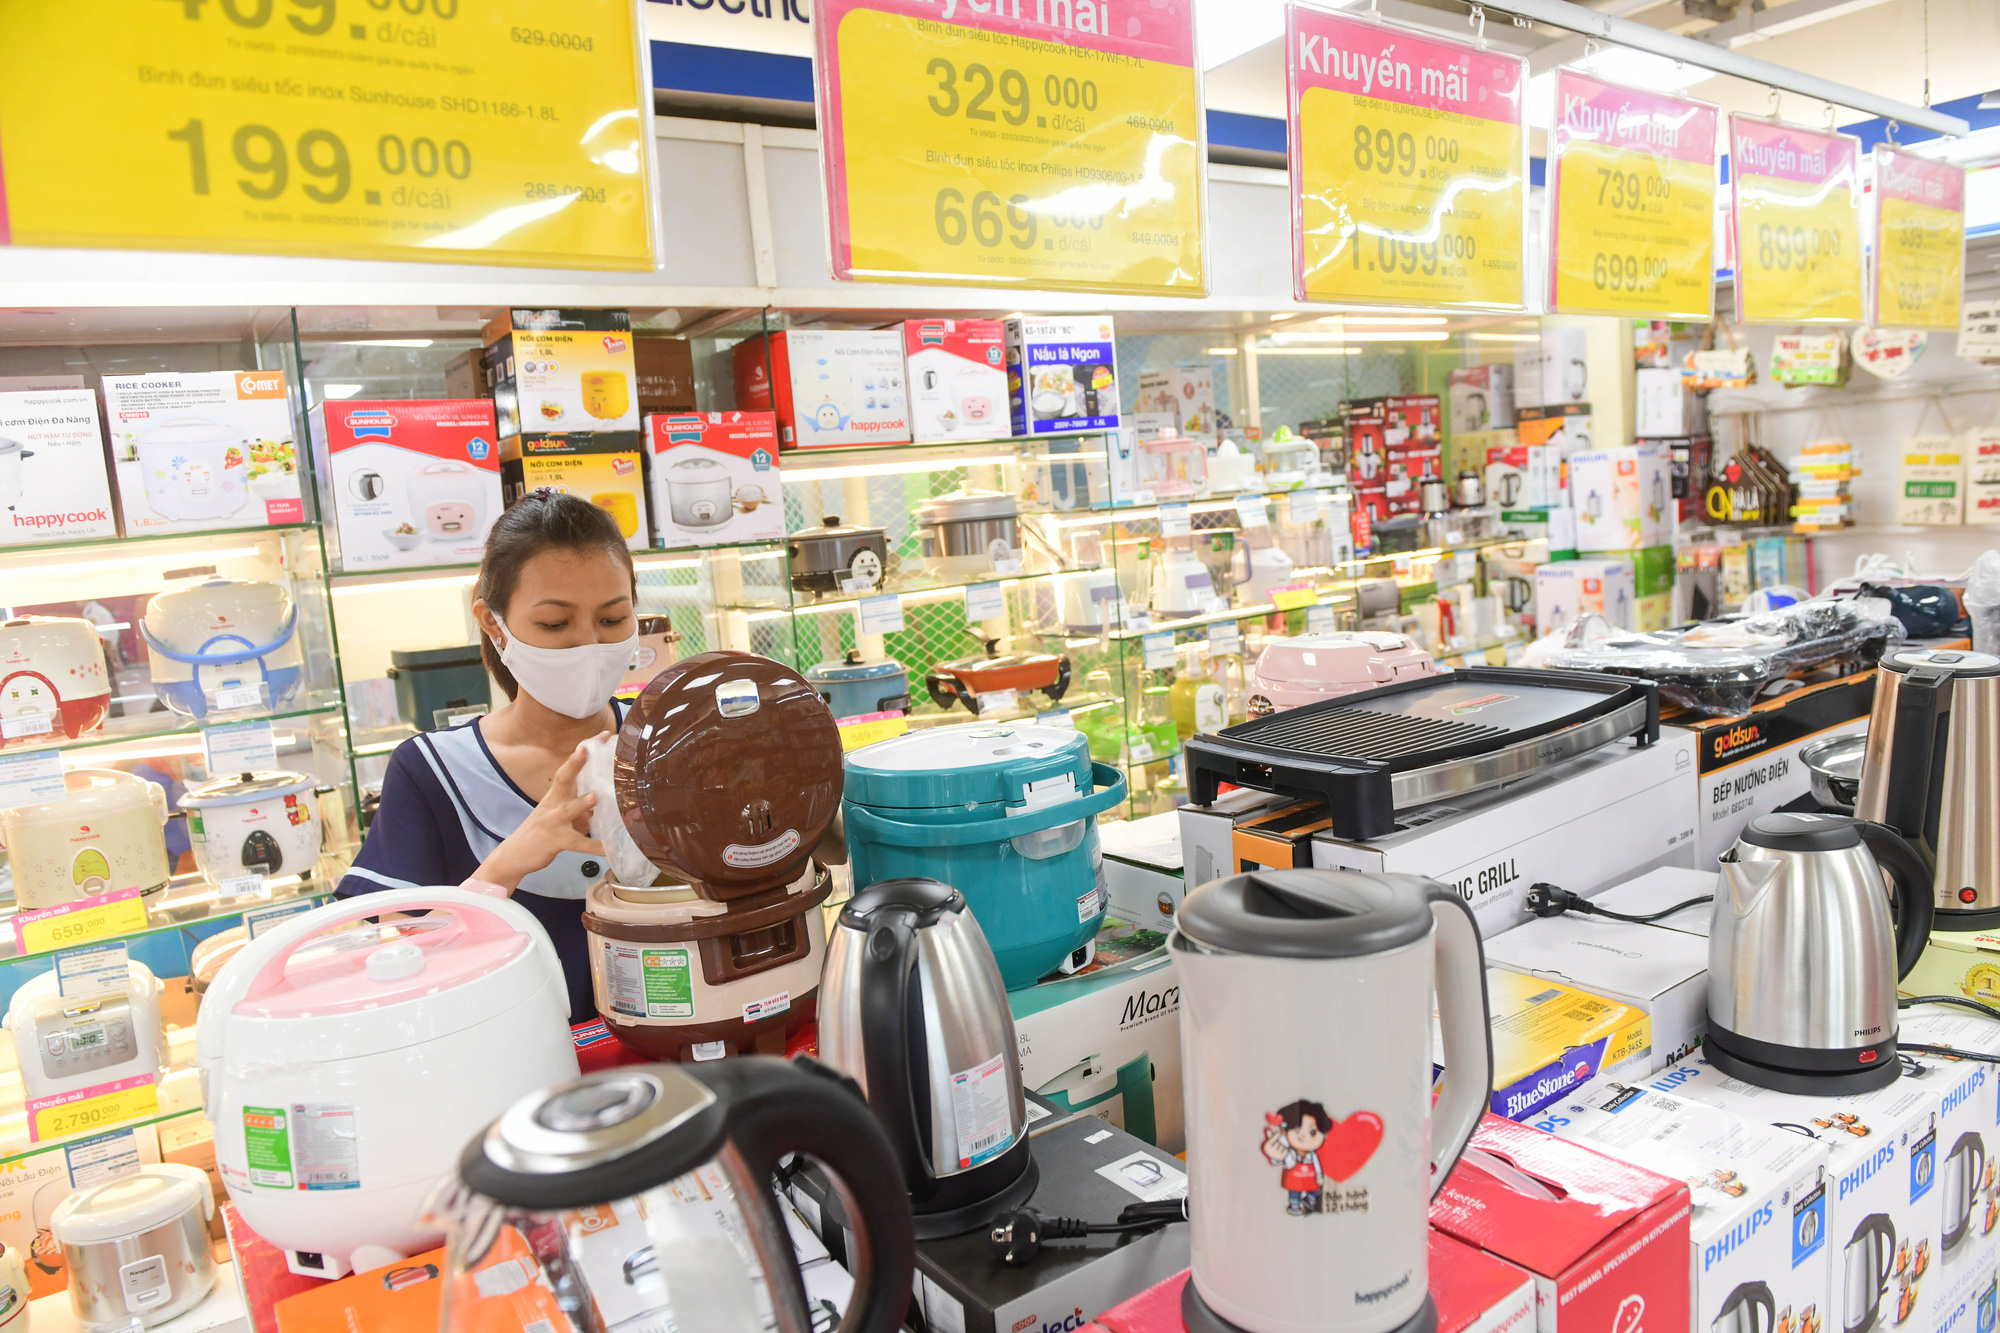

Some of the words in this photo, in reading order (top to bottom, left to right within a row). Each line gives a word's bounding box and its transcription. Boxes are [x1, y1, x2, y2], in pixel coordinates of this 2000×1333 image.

[377, 21, 437, 50] đ/cái
[511, 26, 594, 52] 529.000đ
[917, 18, 943, 33] Bình
[945, 23, 966, 38] đun
[969, 27, 990, 42] siêu
[993, 29, 1008, 46] tốc
[1011, 34, 1067, 57] Happycook
[1069, 45, 1145, 69] HEK-17WF-1.7L
[1300, 31, 1411, 94] Khuyến
[1421, 64, 1468, 102] mãi
[138, 65, 183, 87] Bình
[189, 70, 226, 91] đun
[230, 73, 270, 95] siêu
[272, 74, 300, 98] tốc
[306, 83, 344, 101] inox
[350, 85, 436, 110] Sunhouse
[441, 96, 560, 121] SHD1186-1.8L
[1354, 96, 1367, 108] Bếp
[1393, 104, 1432, 119] SUNHOUSE
[1052, 114, 1086, 133] đ/cái
[1126, 115, 1175, 133] 469.000đ
[1000, 132, 1034, 143] 22/03/2023
[926, 150, 951, 163] Bình
[953, 153, 974, 166] đun
[976, 156, 998, 169] siêu
[1000, 157, 1015, 172] tốc
[1018, 162, 1038, 174] inox
[1041, 162, 1073, 178] Philips
[1737, 135, 1796, 175] Khuyến
[391, 185, 451, 209] đ/cái
[1059, 236, 1091, 252] đ/cái
[1132, 231, 1180, 247] 849.000đ
[1033, 345, 1056, 361] Nấu
[1058, 347, 1069, 360] là
[1071, 347, 1100, 362] Ngon
[141, 381, 182, 389] COOKER
[24, 397, 88, 406] happycook.com.vn
[5, 418, 26, 427] cơm
[28, 417, 50, 426] Điện
[66, 416, 91, 425] Năng
[851, 418, 905, 433] happycook
[471, 442, 483, 451] 12
[527, 438, 567, 451] goldsun
[755, 453, 767, 463] 12
[13, 507, 108, 528] happycook
[1714, 725, 1759, 758] goldsun
[1713, 778, 1732, 804] BẾP
[1734, 765, 1766, 796] NƯỚNG
[1769, 757, 1789, 781] ĐIỆN
[1712, 808, 1731, 822] Model:
[70, 833, 101, 843] happycook
[1478, 858, 1519, 895] GRILL
[1489, 888, 1514, 905] effortlessly
[18, 910, 52, 924] Khuyến
[53, 905, 70, 916] mãi
[74, 1018, 95, 1026] TOSHIBA
[1120, 1021, 1143, 1032] Premium
[1144, 1014, 1159, 1024] Brand
[1854, 1026, 1881, 1037] PHILIPS
[1627, 1028, 1642, 1041] Model
[33, 1096, 66, 1110] Khuyến
[68, 1091, 84, 1102] mãi
[1507, 1070, 1575, 1118] BlueStone
[1603, 1099, 1615, 1112] Daily
[1615, 1090, 1635, 1103] Collection
[1941, 1066, 1985, 1118] PHILIPS
[68, 1142, 82, 1151] Thông
[1911, 1145, 1920, 1156] Daily
[1920, 1135, 1934, 1149] Collection
[16, 1170, 36, 1183] Lẩu
[38, 1165, 61, 1177] Điện
[1839, 1141, 1895, 1201] PHILIPS
[1446, 1187, 1486, 1211] kettle
[1794, 1203, 1804, 1214] Daily
[1803, 1190, 1822, 1207] Collection
[1325, 1203, 1338, 1213] 12
[1340, 1201, 1369, 1217] tháng
[1705, 1200, 1774, 1272] PHILIPS
[1560, 1287, 1578, 1306] BEST
[1578, 1273, 1603, 1295] BRAND,
[1603, 1240, 1642, 1275] SPECIALIZED
[1641, 1237, 1650, 1250] IN
[1649, 1205, 1690, 1242] KITCHENWARE
[1355, 1274, 1409, 1305] happycook
[1013, 1315, 1036, 1332] COOP
